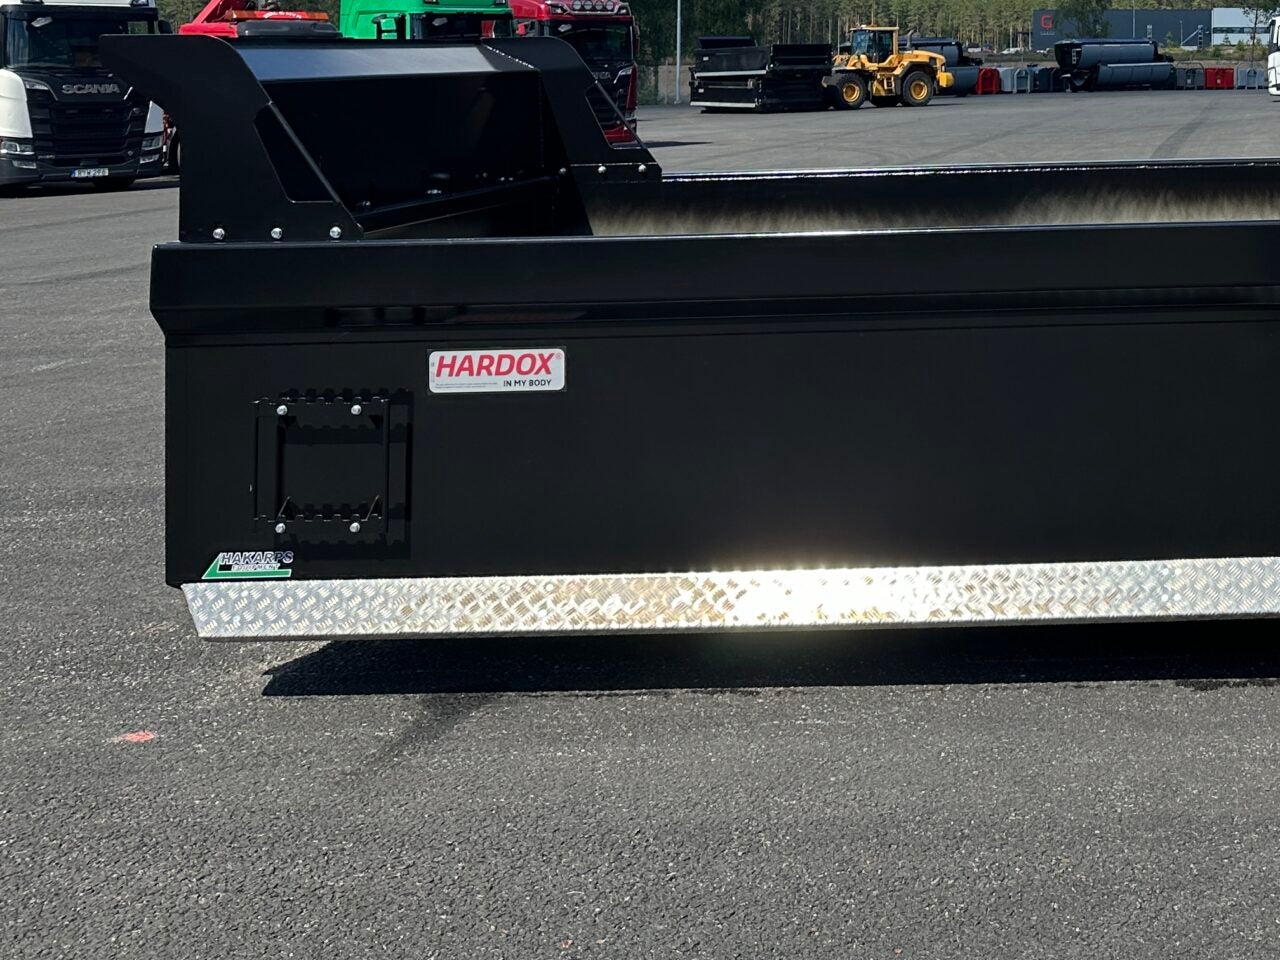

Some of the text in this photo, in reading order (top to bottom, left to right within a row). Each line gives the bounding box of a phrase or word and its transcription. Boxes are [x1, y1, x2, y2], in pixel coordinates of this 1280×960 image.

[61, 83, 121, 94] SCANIA
[435, 352, 556, 378] HARDOX
[503, 380, 512, 388] IN
[513, 379, 527, 387] MY
[528, 379, 552, 387] BODY
[219, 550, 294, 565] HAKARPS
